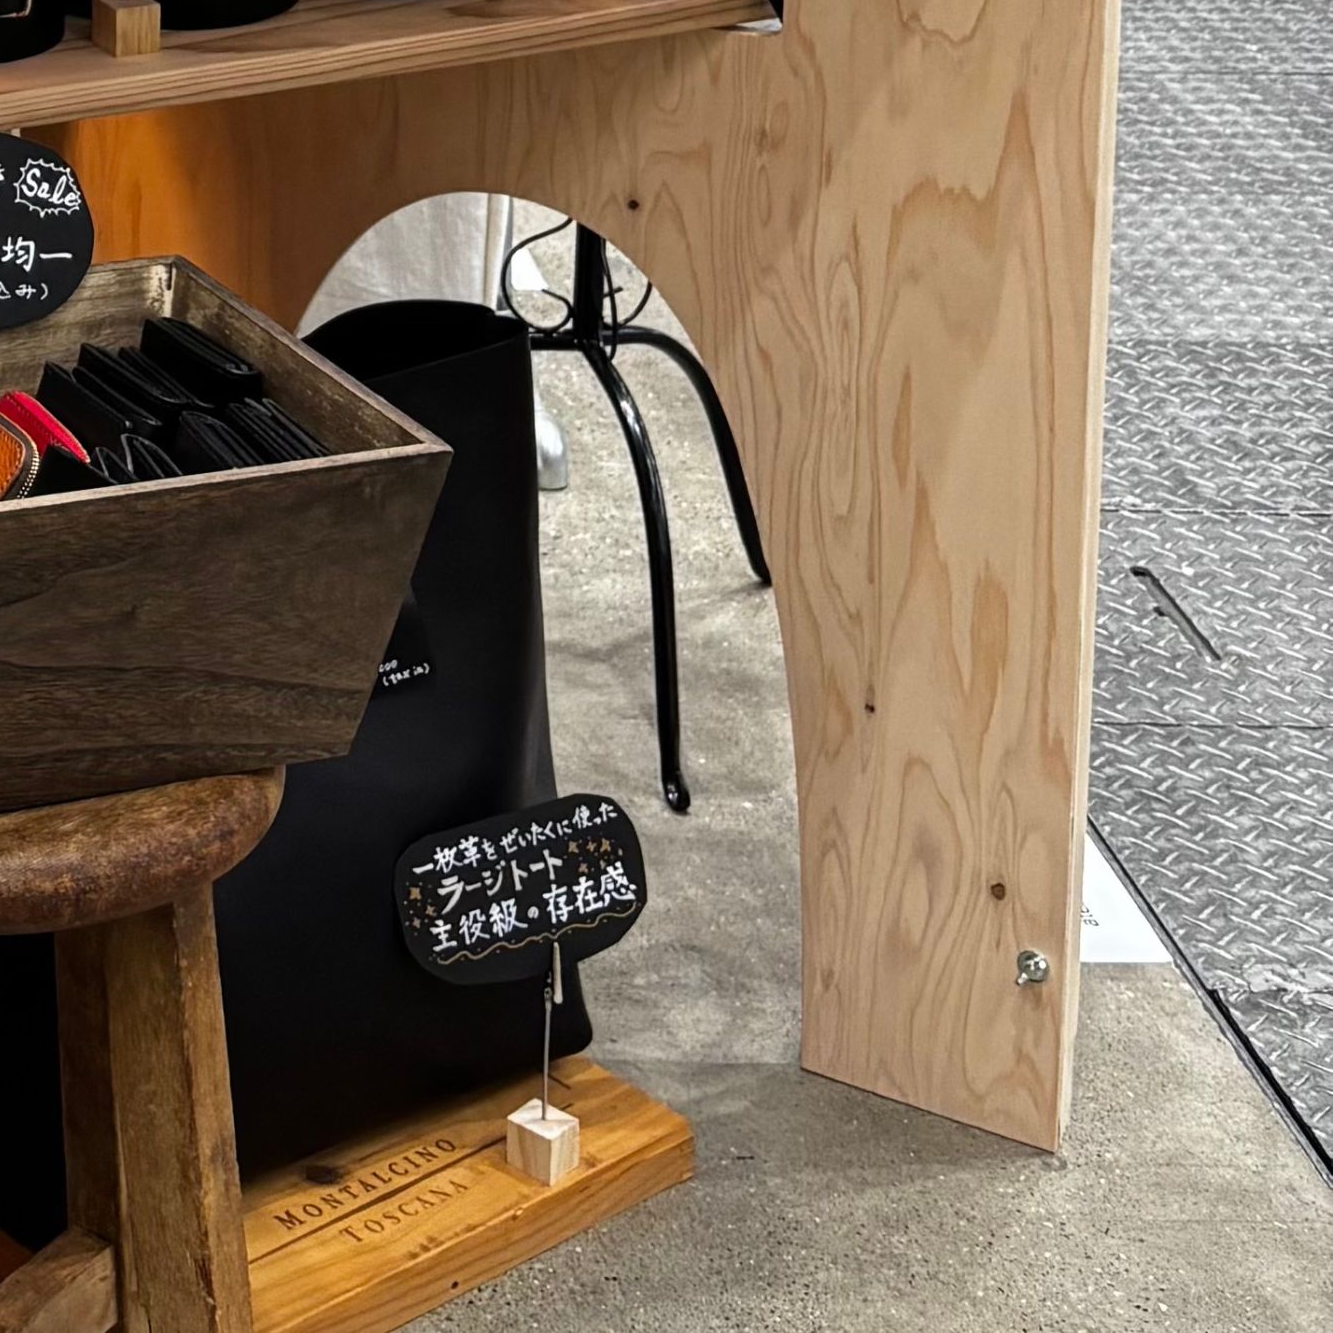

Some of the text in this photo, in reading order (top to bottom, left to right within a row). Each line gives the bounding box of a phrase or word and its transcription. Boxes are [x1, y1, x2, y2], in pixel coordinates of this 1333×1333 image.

[25, 167, 78, 207] Sale
[413, 802, 618, 874] 一枚革をぜいたくに使った
[430, 862, 636, 952] 主役級の存在感
[437, 849, 563, 915] ラージトート
[273, 1139, 456, 1230] MONTALCINO
[339, 1180, 468, 1242] TOSCANA
